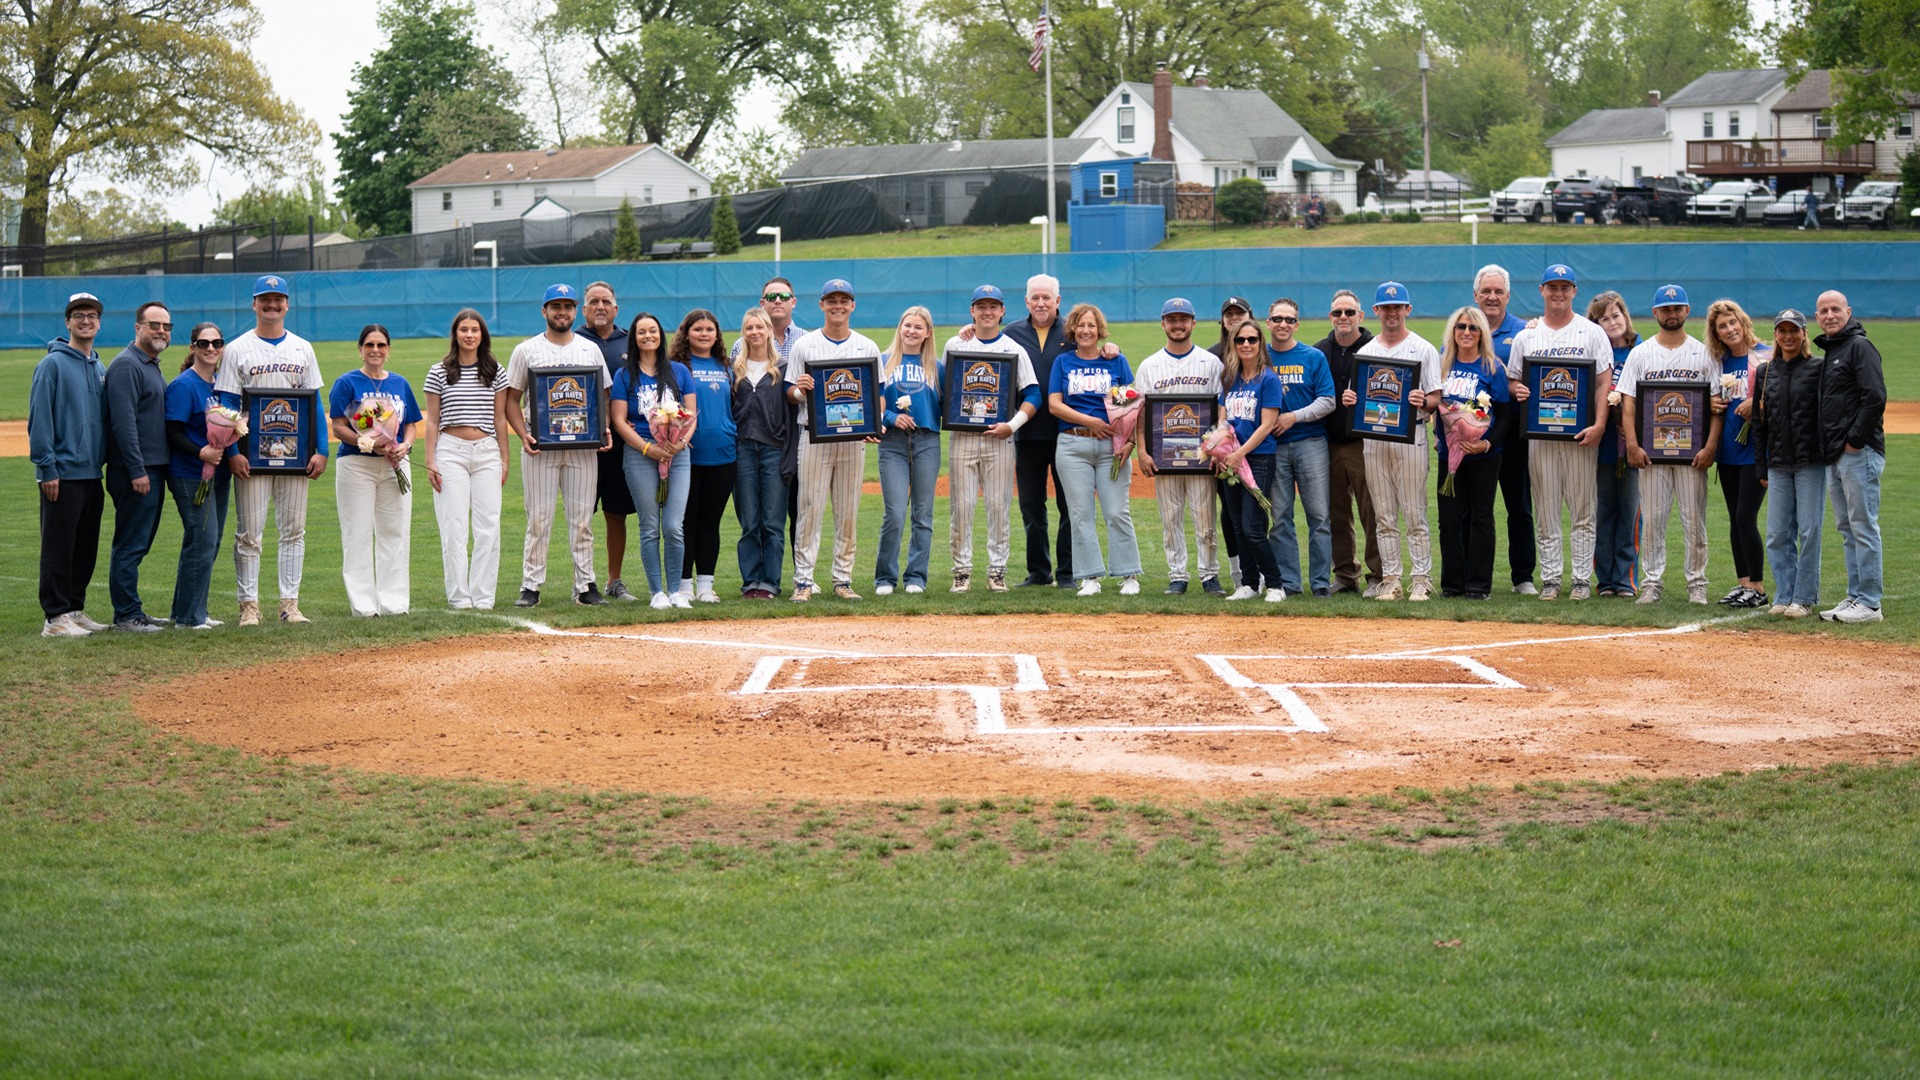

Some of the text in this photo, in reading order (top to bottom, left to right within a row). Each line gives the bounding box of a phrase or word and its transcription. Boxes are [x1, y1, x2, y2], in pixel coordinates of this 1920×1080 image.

[1530, 346, 1585, 357] CHARGERS
[250, 363, 305, 376] CHARGERS
[1070, 367, 1109, 376] SENIOR
[1280, 364, 1304, 375] HAVEN
[1447, 370, 1479, 379] ENIOR
[1645, 369, 1699, 380] CHARGERS
[884, 364, 904, 390] EW
[967, 375, 996, 386] NEW HAVEN
[1278, 374, 1304, 384] EBALL
[828, 382, 858, 394] NEW HAVEN
[1068, 373, 1112, 395] MOM
[1154, 376, 1210, 390] CHARGERS
[1370, 381, 1399, 394] NEW HAVEN
[1543, 381, 1574, 392] NEW HAVEN
[552, 391, 583, 402] NEW HAVEN
[1226, 390, 1256, 398] SENIOR
[1225, 397, 1258, 421] MOM
[1658, 406, 1689, 417] NEW HAVEN
[264, 414, 295, 425] NEW HAVEN
[1166, 418, 1196, 428] NEW HAVEN
